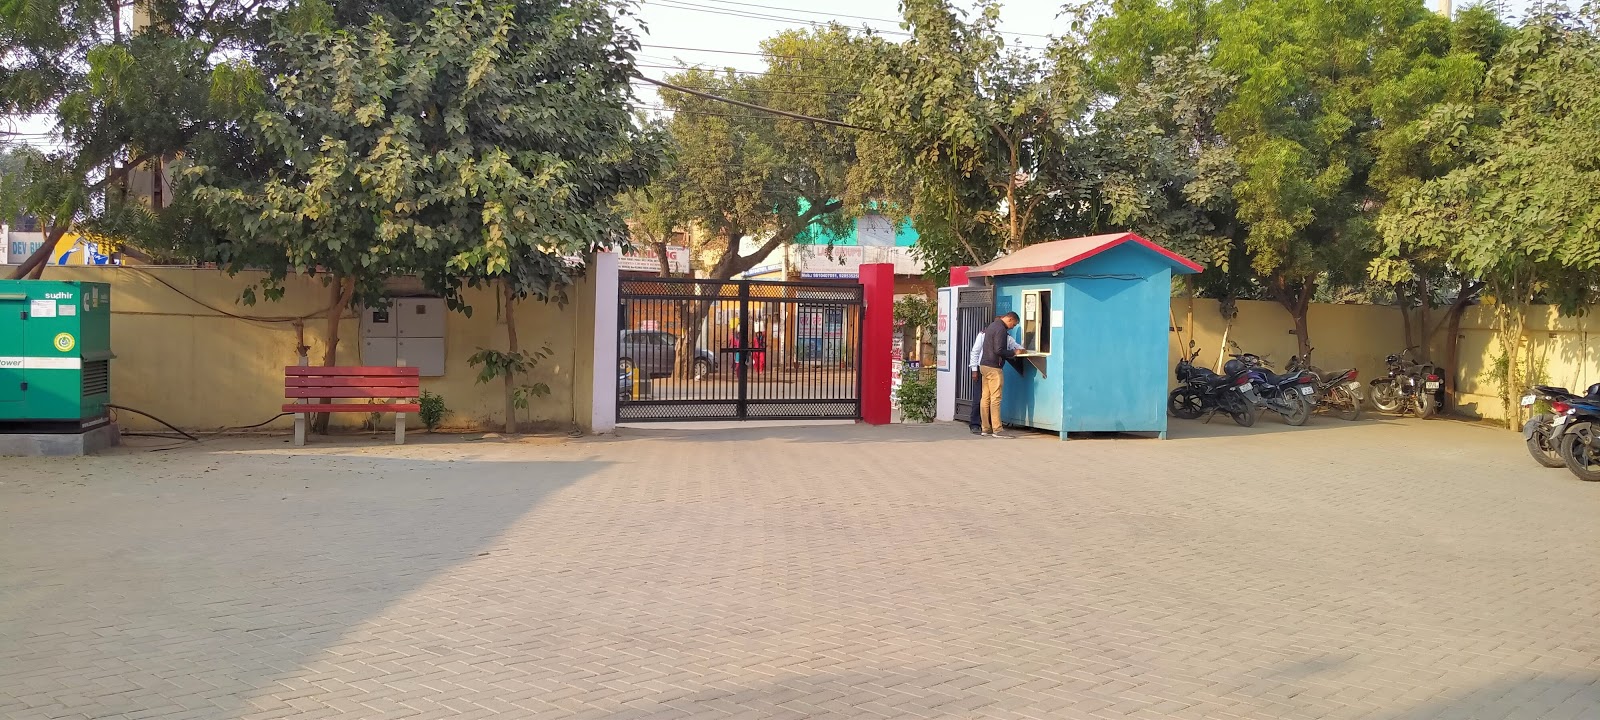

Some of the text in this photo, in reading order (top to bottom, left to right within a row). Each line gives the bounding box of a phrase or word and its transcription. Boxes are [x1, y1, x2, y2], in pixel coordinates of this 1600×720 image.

[12, 241, 27, 255] DEV
[45, 291, 73, 300] sudhir
[0, 359, 22, 367] ower
